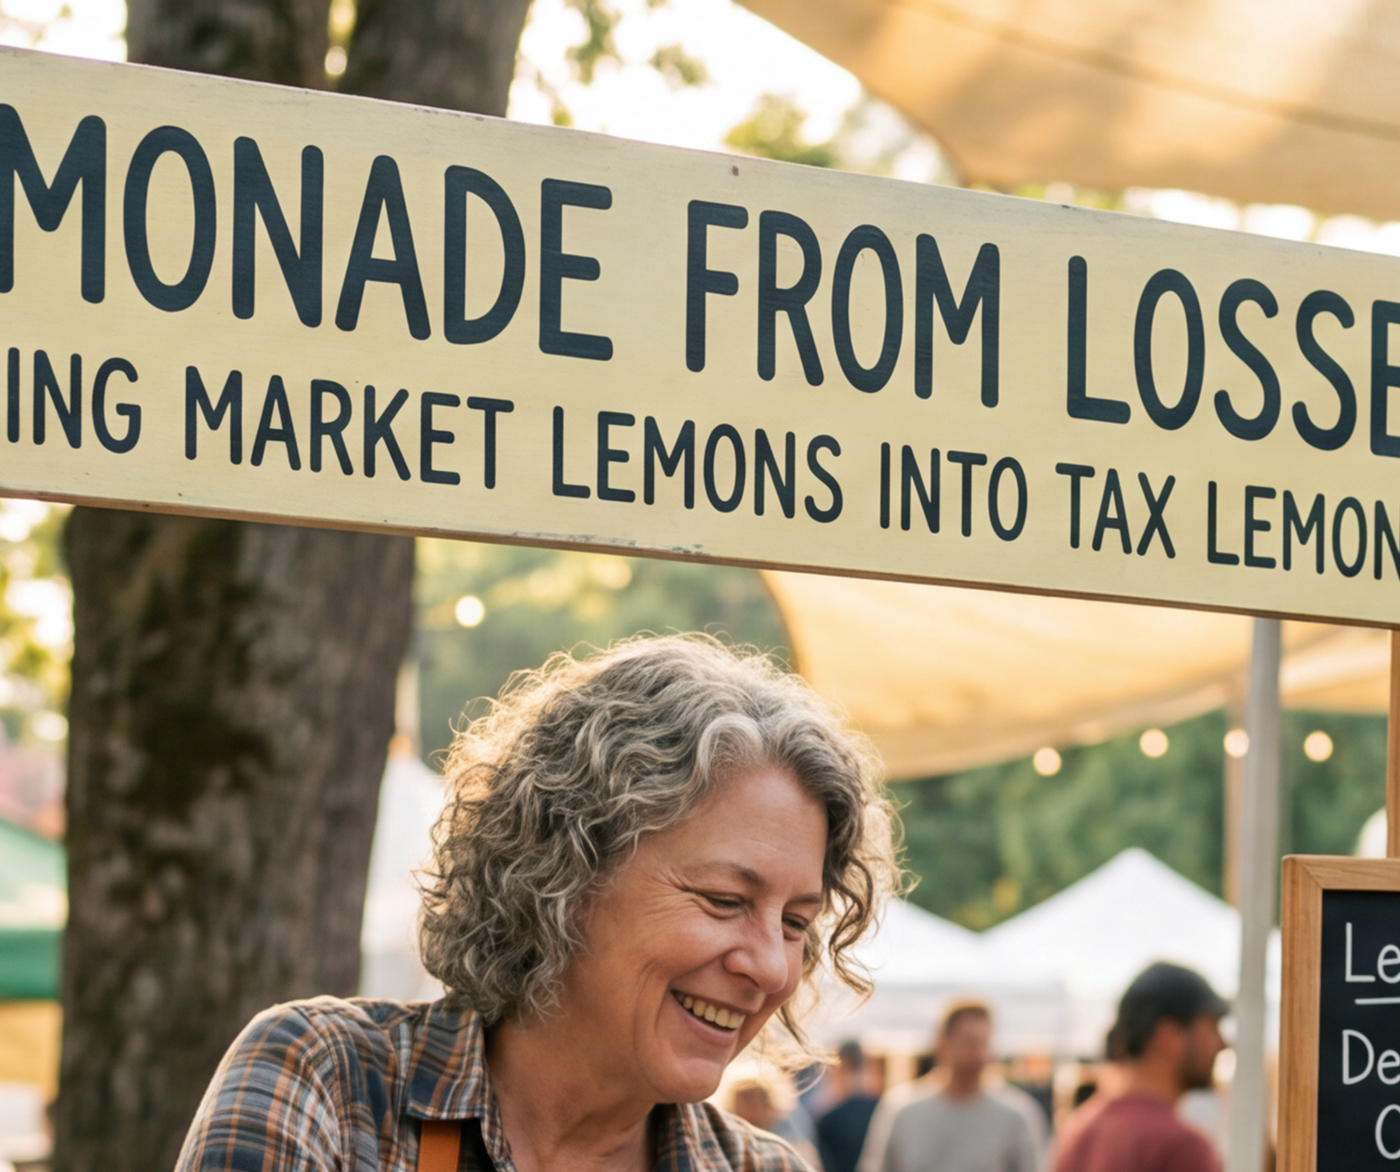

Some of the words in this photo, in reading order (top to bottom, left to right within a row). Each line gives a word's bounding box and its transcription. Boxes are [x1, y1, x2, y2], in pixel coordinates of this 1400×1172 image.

[685, 199, 1001, 409] FROM
[184, 365, 515, 490] MARKET
[552, 405, 844, 524] LEMONS
[879, 441, 1028, 542] INTO
[1055, 462, 1176, 559] TAX
